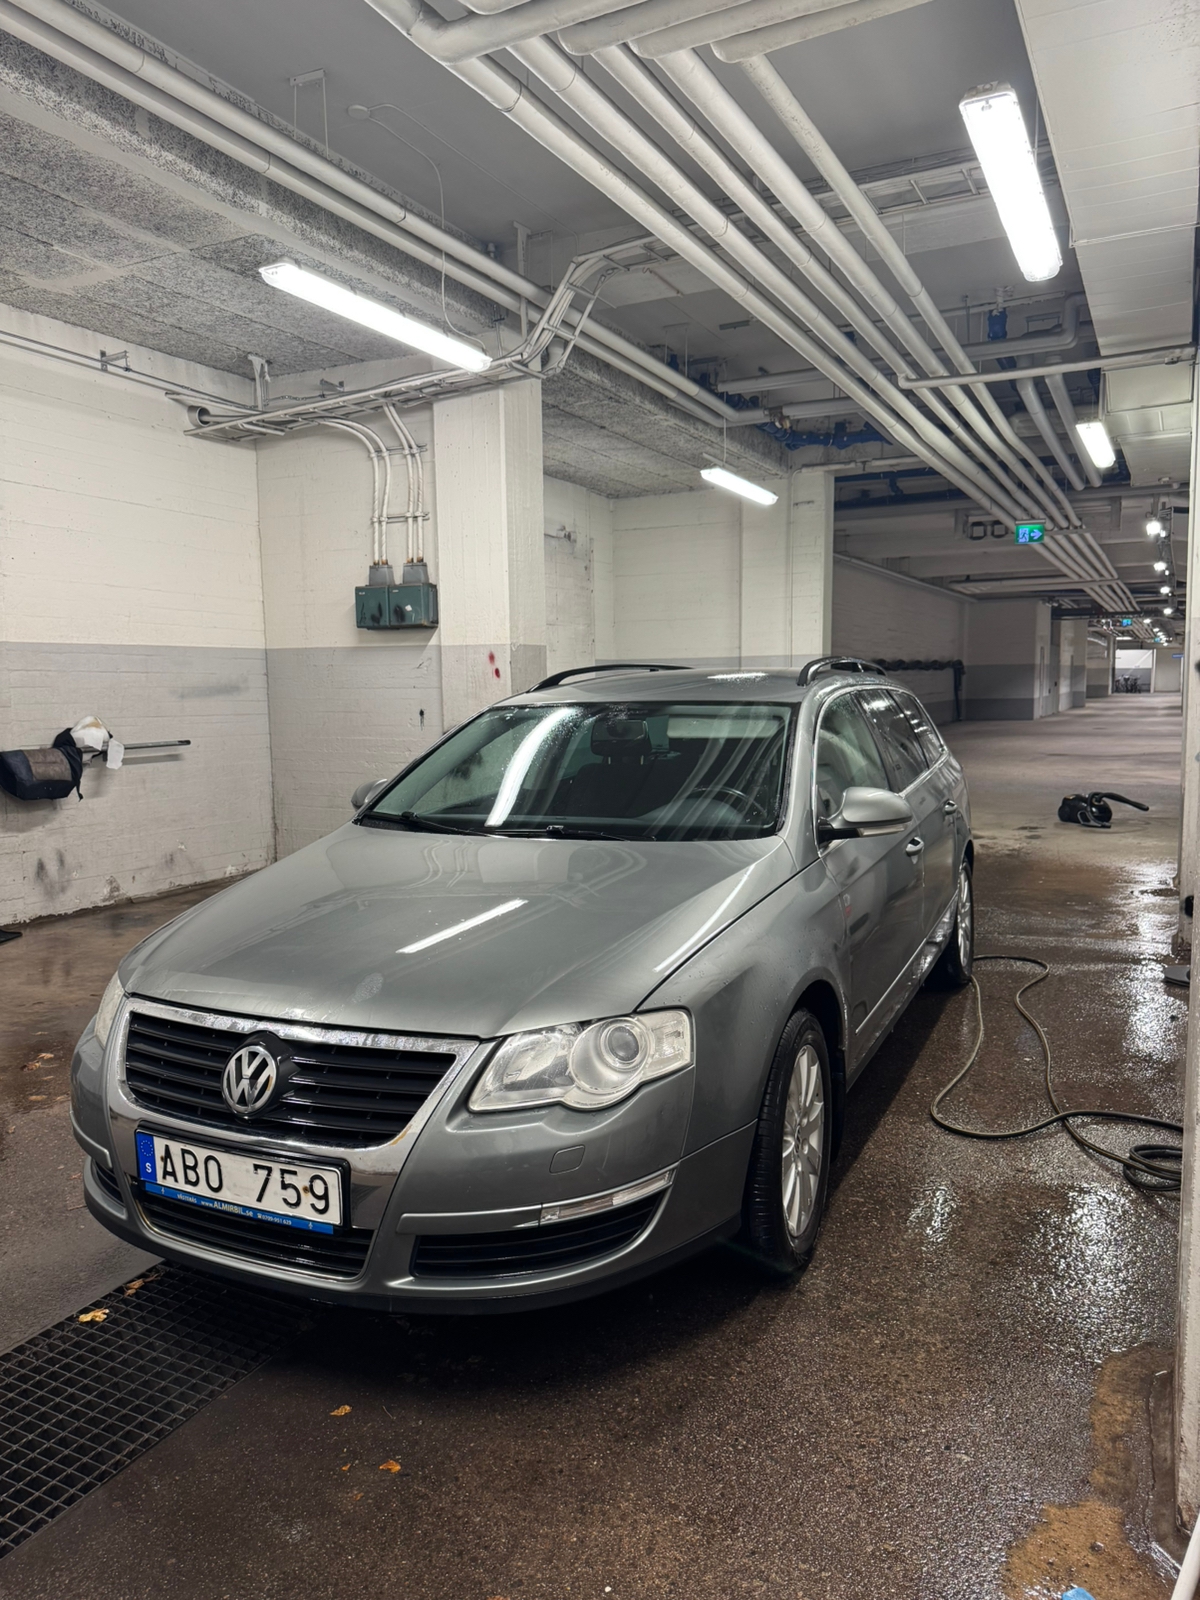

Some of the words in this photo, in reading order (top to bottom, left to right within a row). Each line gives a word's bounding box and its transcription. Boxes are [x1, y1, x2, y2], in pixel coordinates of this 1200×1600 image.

[222, 1045, 277, 1114] VW
[145, 1162, 152, 1173] S
[161, 1143, 223, 1193] ABO
[252, 1163, 330, 1215] 759
